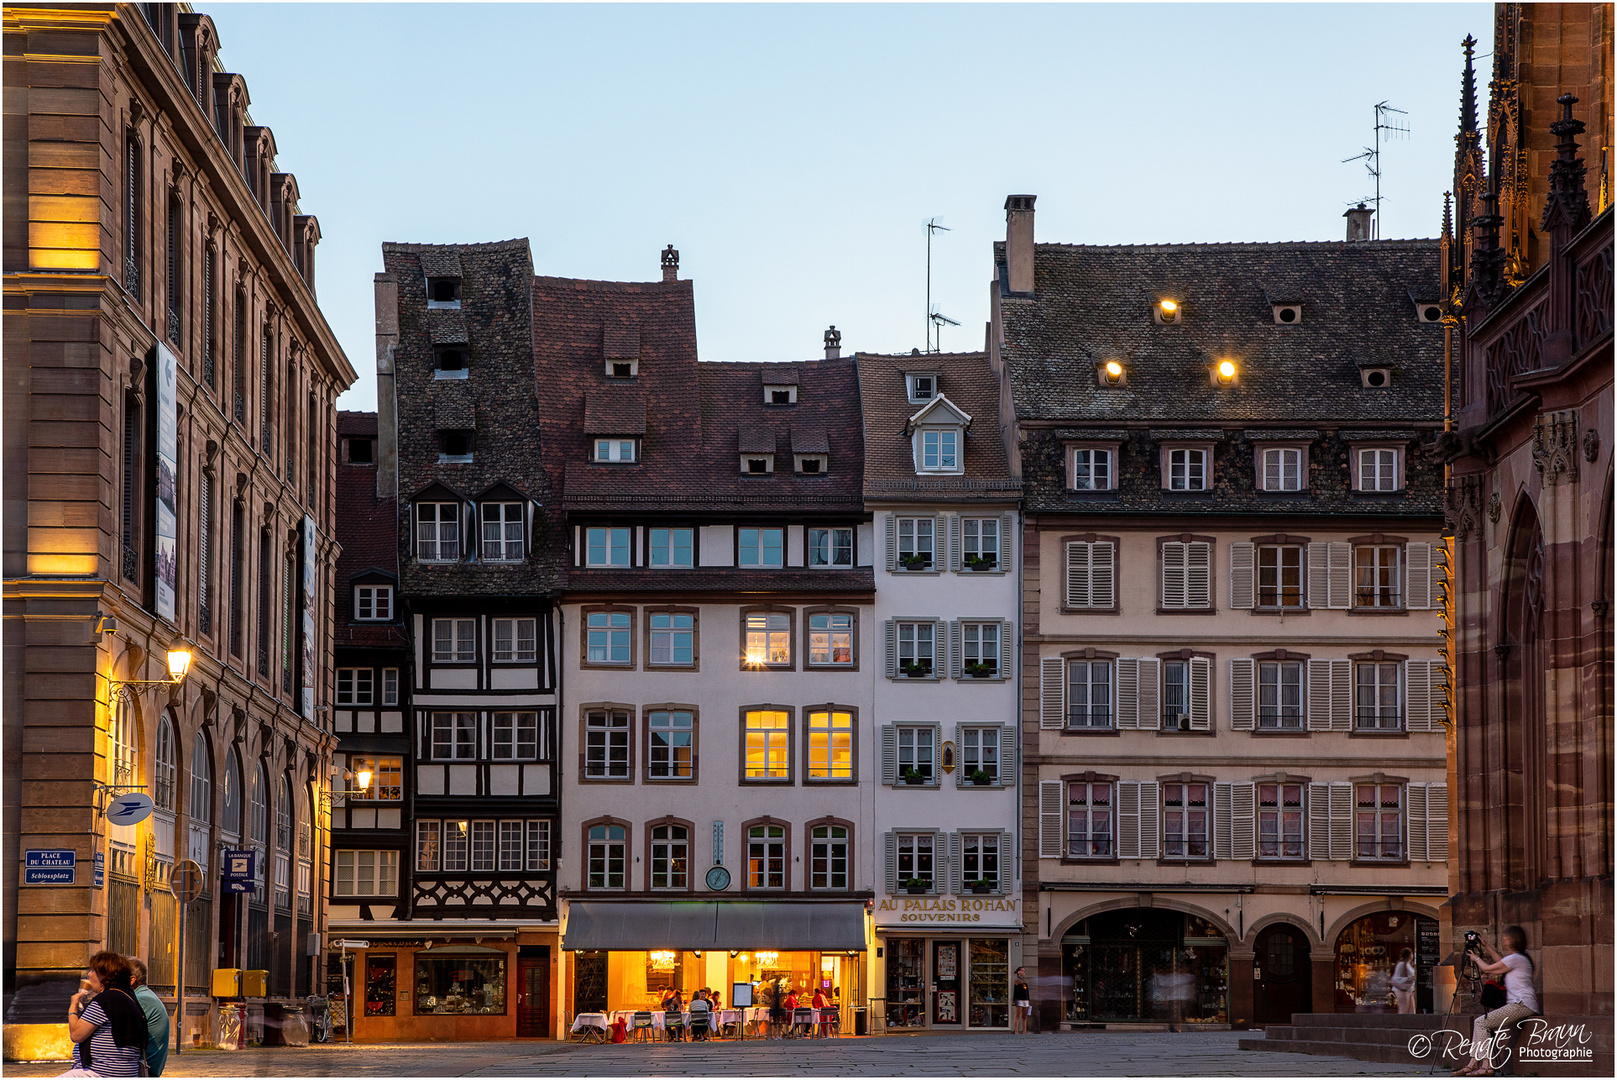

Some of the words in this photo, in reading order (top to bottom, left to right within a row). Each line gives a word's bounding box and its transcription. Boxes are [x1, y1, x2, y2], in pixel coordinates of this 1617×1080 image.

[878, 899, 898, 911] AU
[904, 899, 956, 911] PALAIS
[961, 899, 1016, 911] ROHAN
[900, 913, 980, 922] SOUVENIRS
